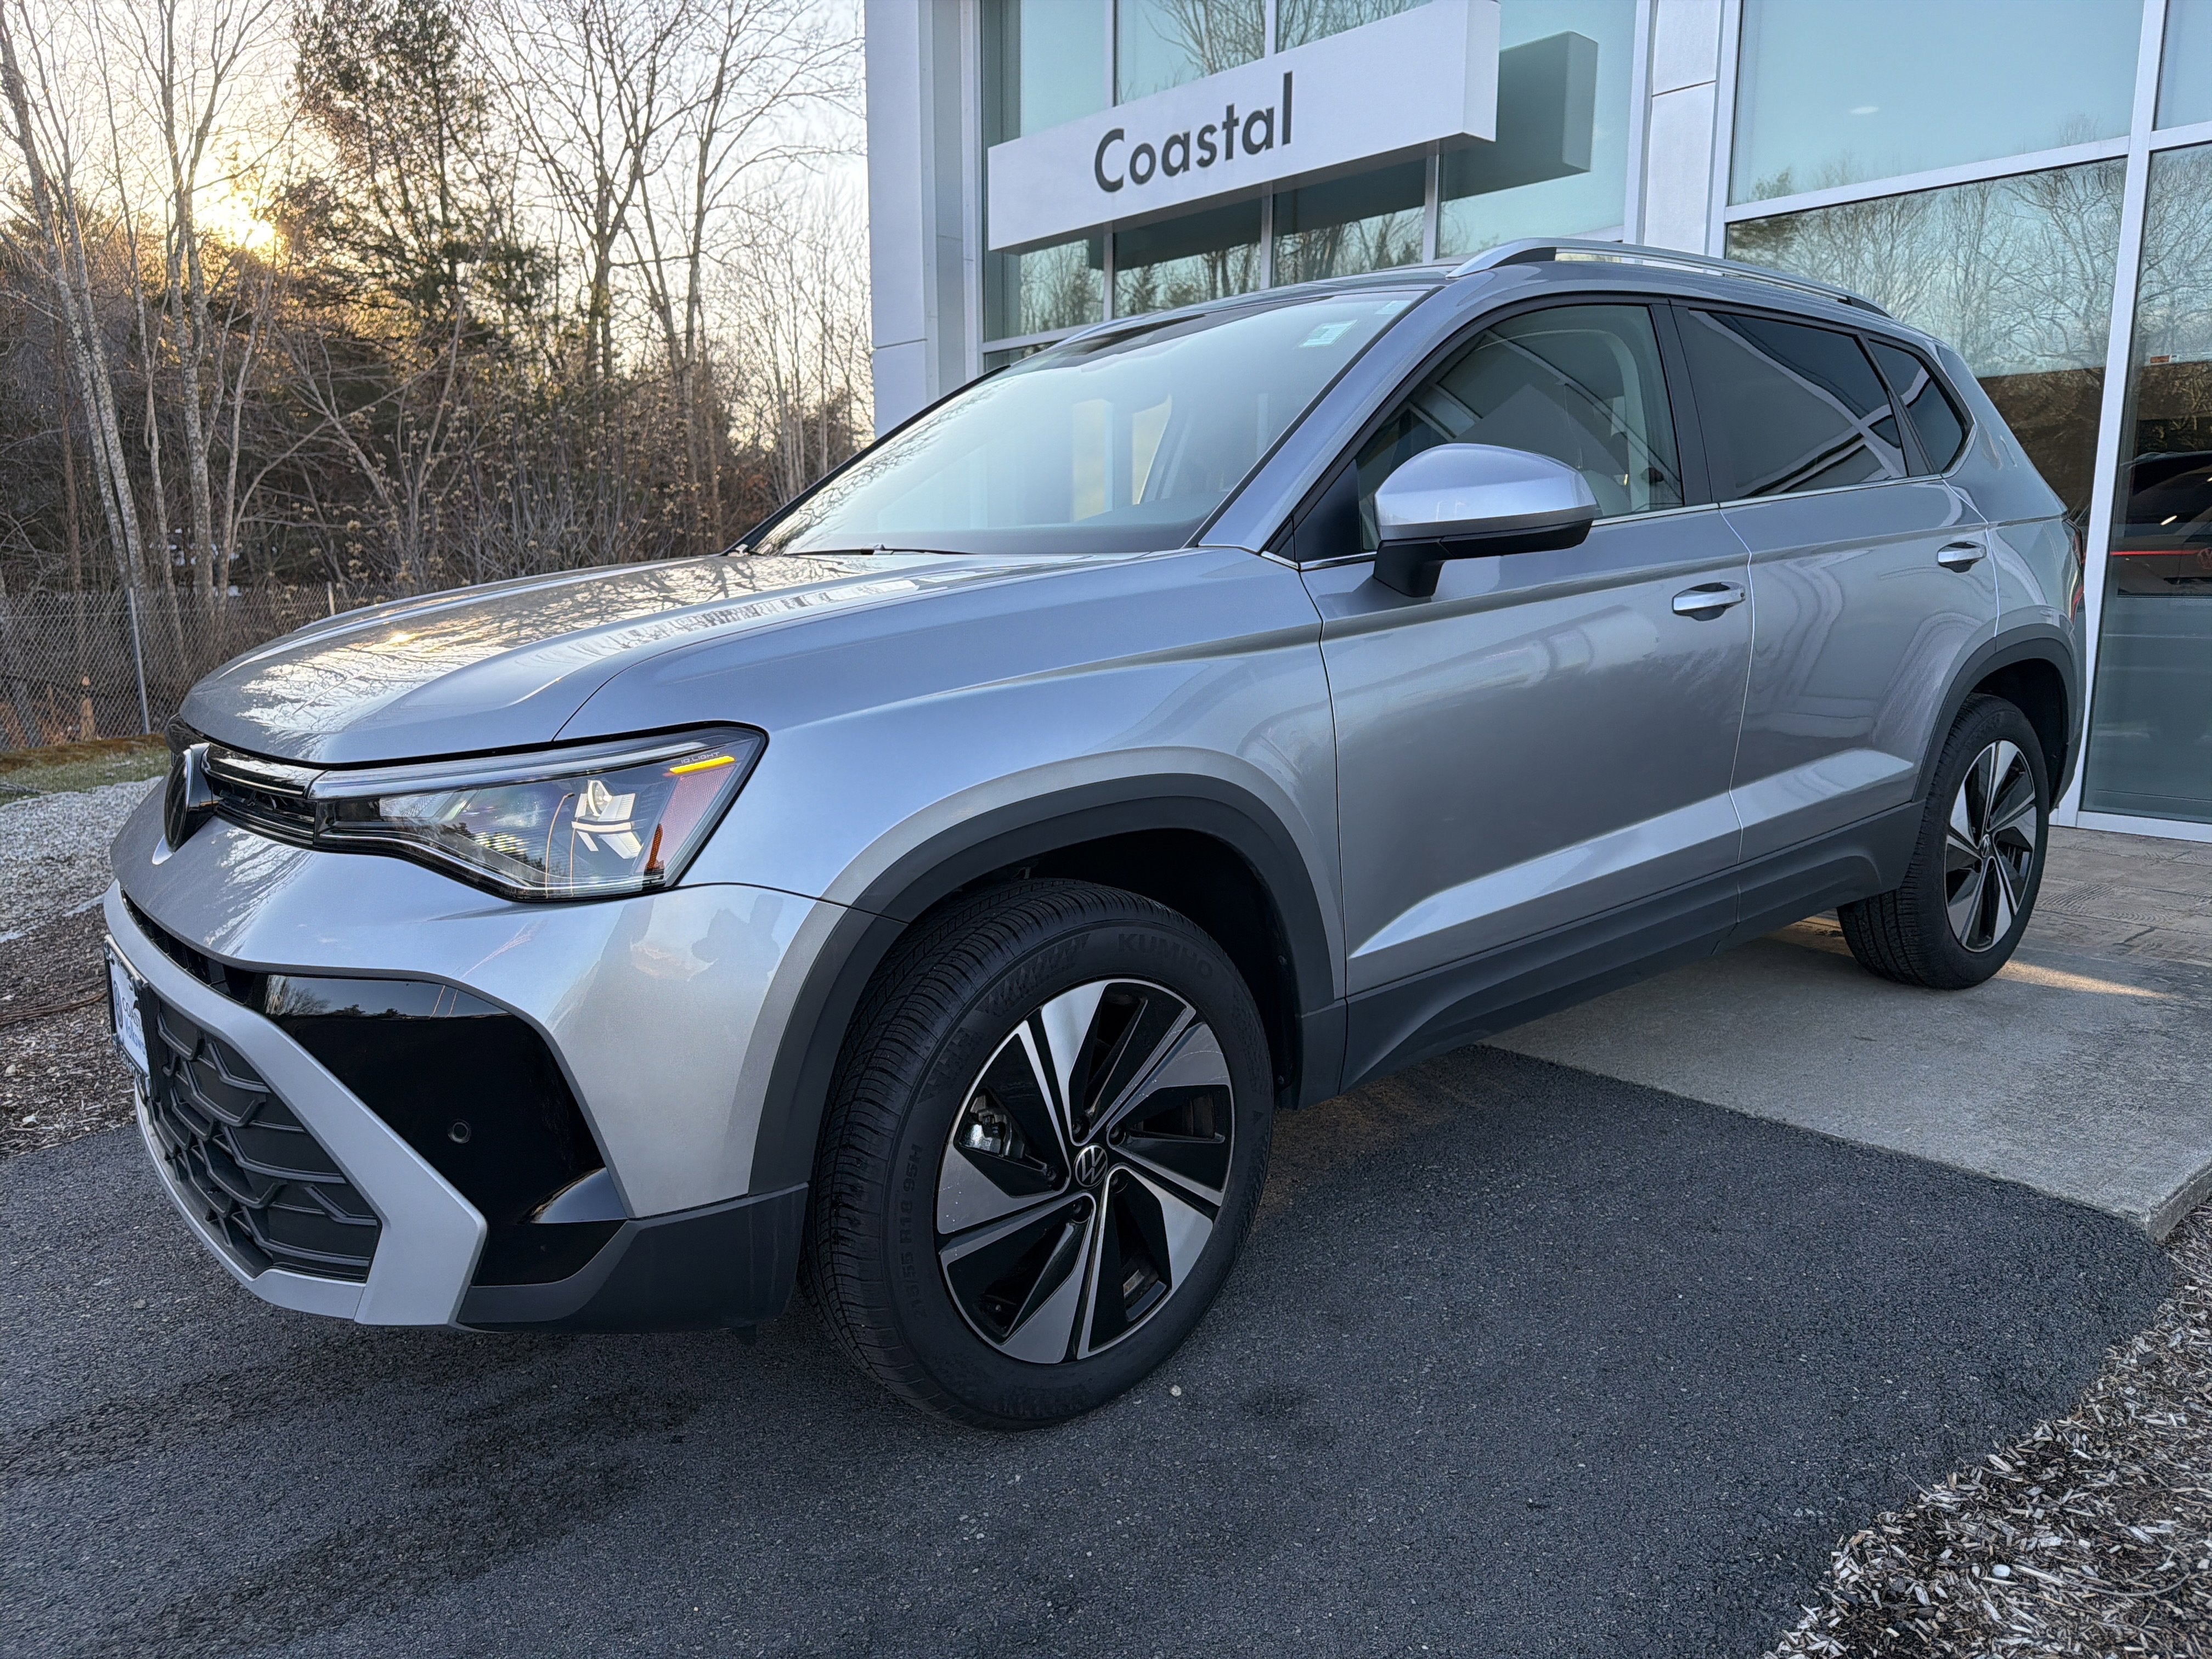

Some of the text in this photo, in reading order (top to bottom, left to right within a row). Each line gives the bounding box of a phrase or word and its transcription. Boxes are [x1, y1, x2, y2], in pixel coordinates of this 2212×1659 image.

[1094, 71, 1293, 193] Coastal
[681, 751, 720, 764] IQ.LIGHT
[1118, 933, 1214, 979] KUMHO
[902, 1143, 923, 1192] 95H
[899, 1201, 913, 1244] R18
